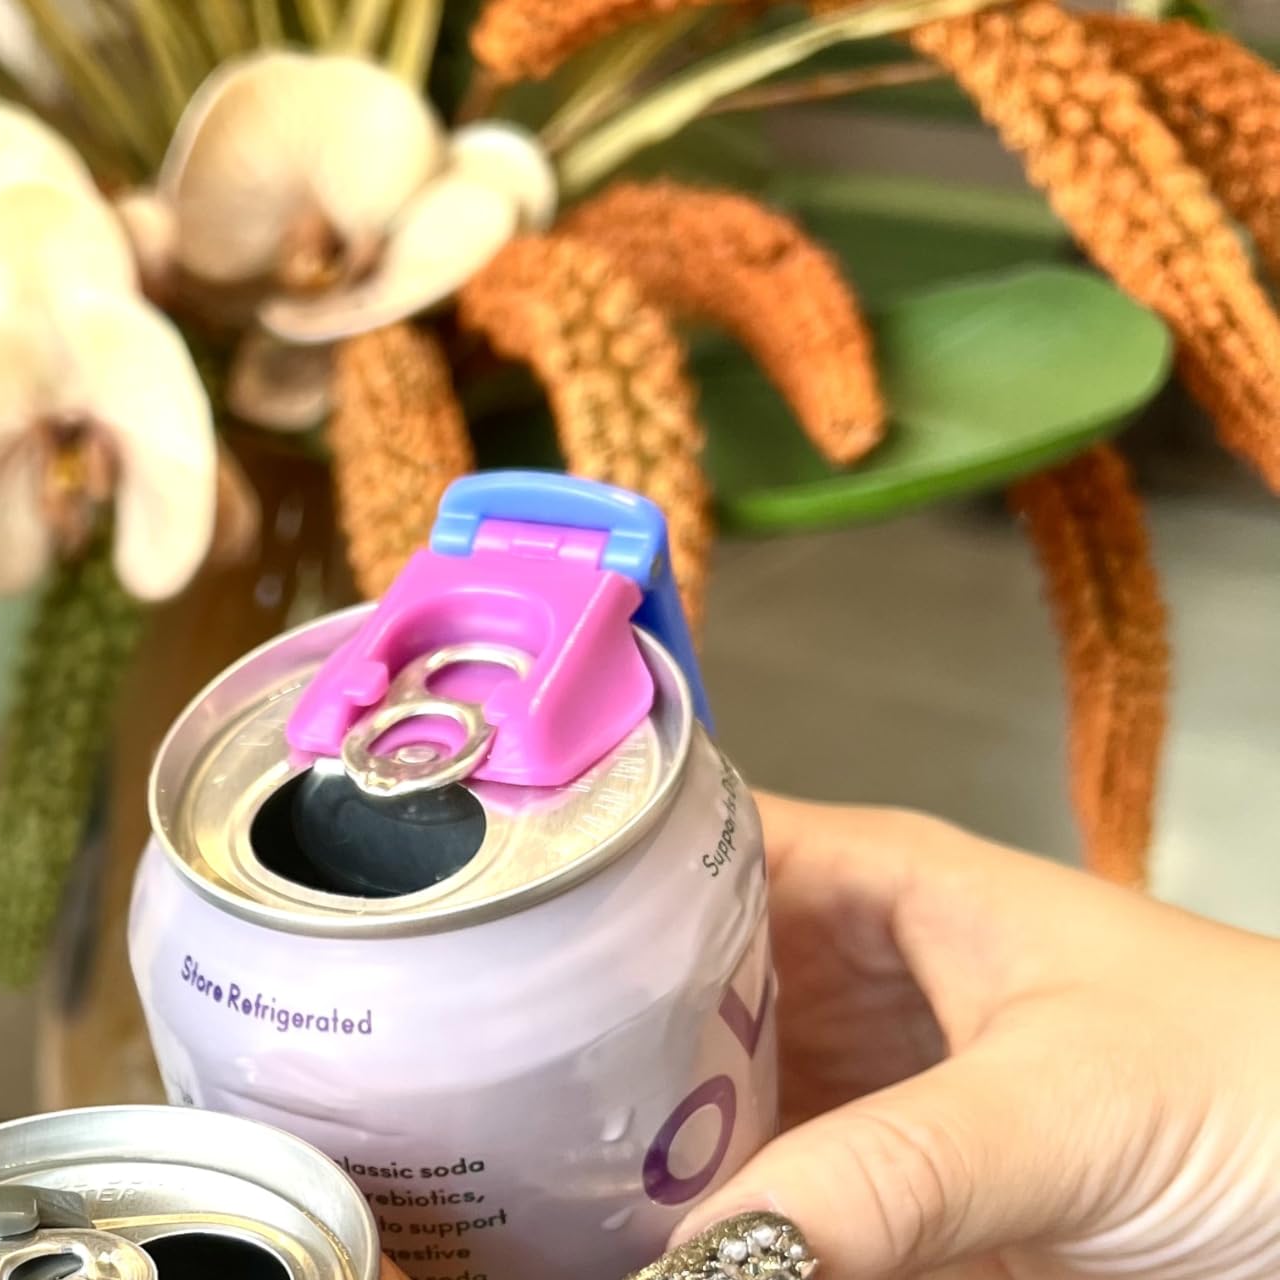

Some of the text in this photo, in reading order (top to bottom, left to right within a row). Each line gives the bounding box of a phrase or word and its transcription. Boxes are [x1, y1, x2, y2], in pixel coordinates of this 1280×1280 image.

[181, 955, 372, 1034] Store Refrigerated
[421, 1158, 485, 1178] soda
[365, 1189, 485, 1207] rebiotics,
[380, 1209, 507, 1237] to support
